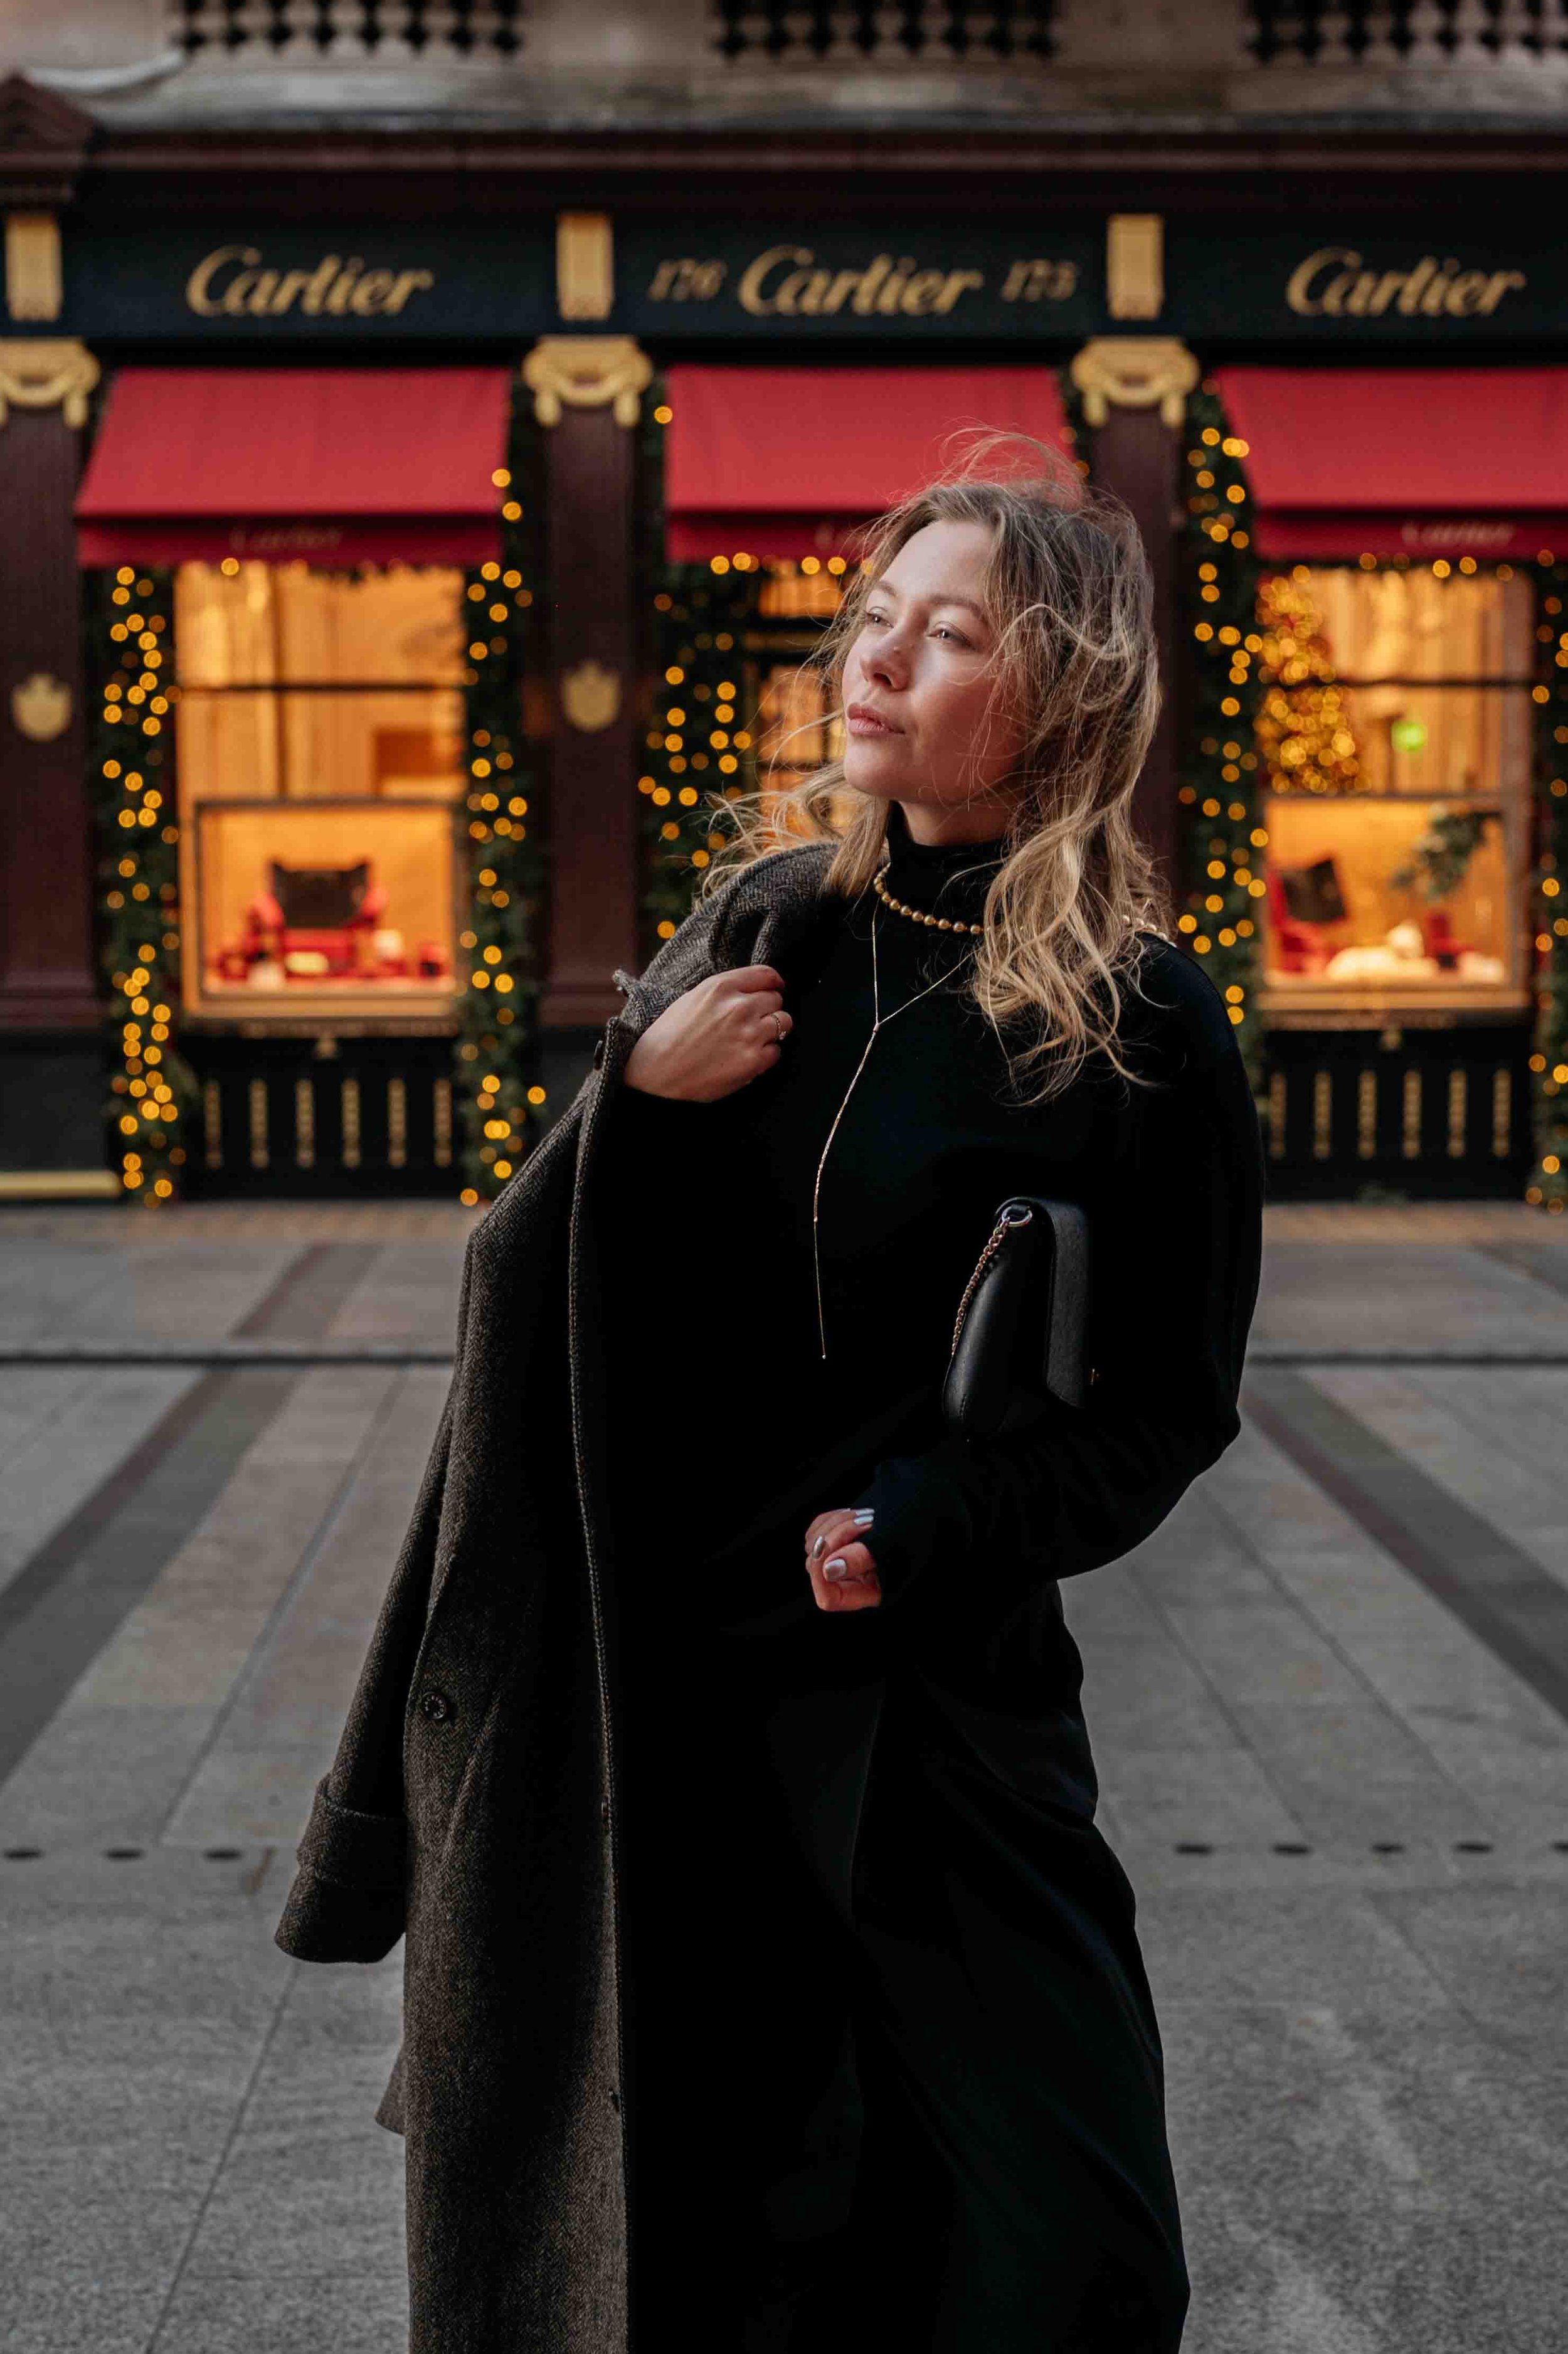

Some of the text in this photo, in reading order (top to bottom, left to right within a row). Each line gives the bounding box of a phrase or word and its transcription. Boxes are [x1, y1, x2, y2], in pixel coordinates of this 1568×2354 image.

[187, 245, 433, 315] Cartier
[738, 245, 983, 315] Cartier
[1286, 247, 1526, 315] Cartier
